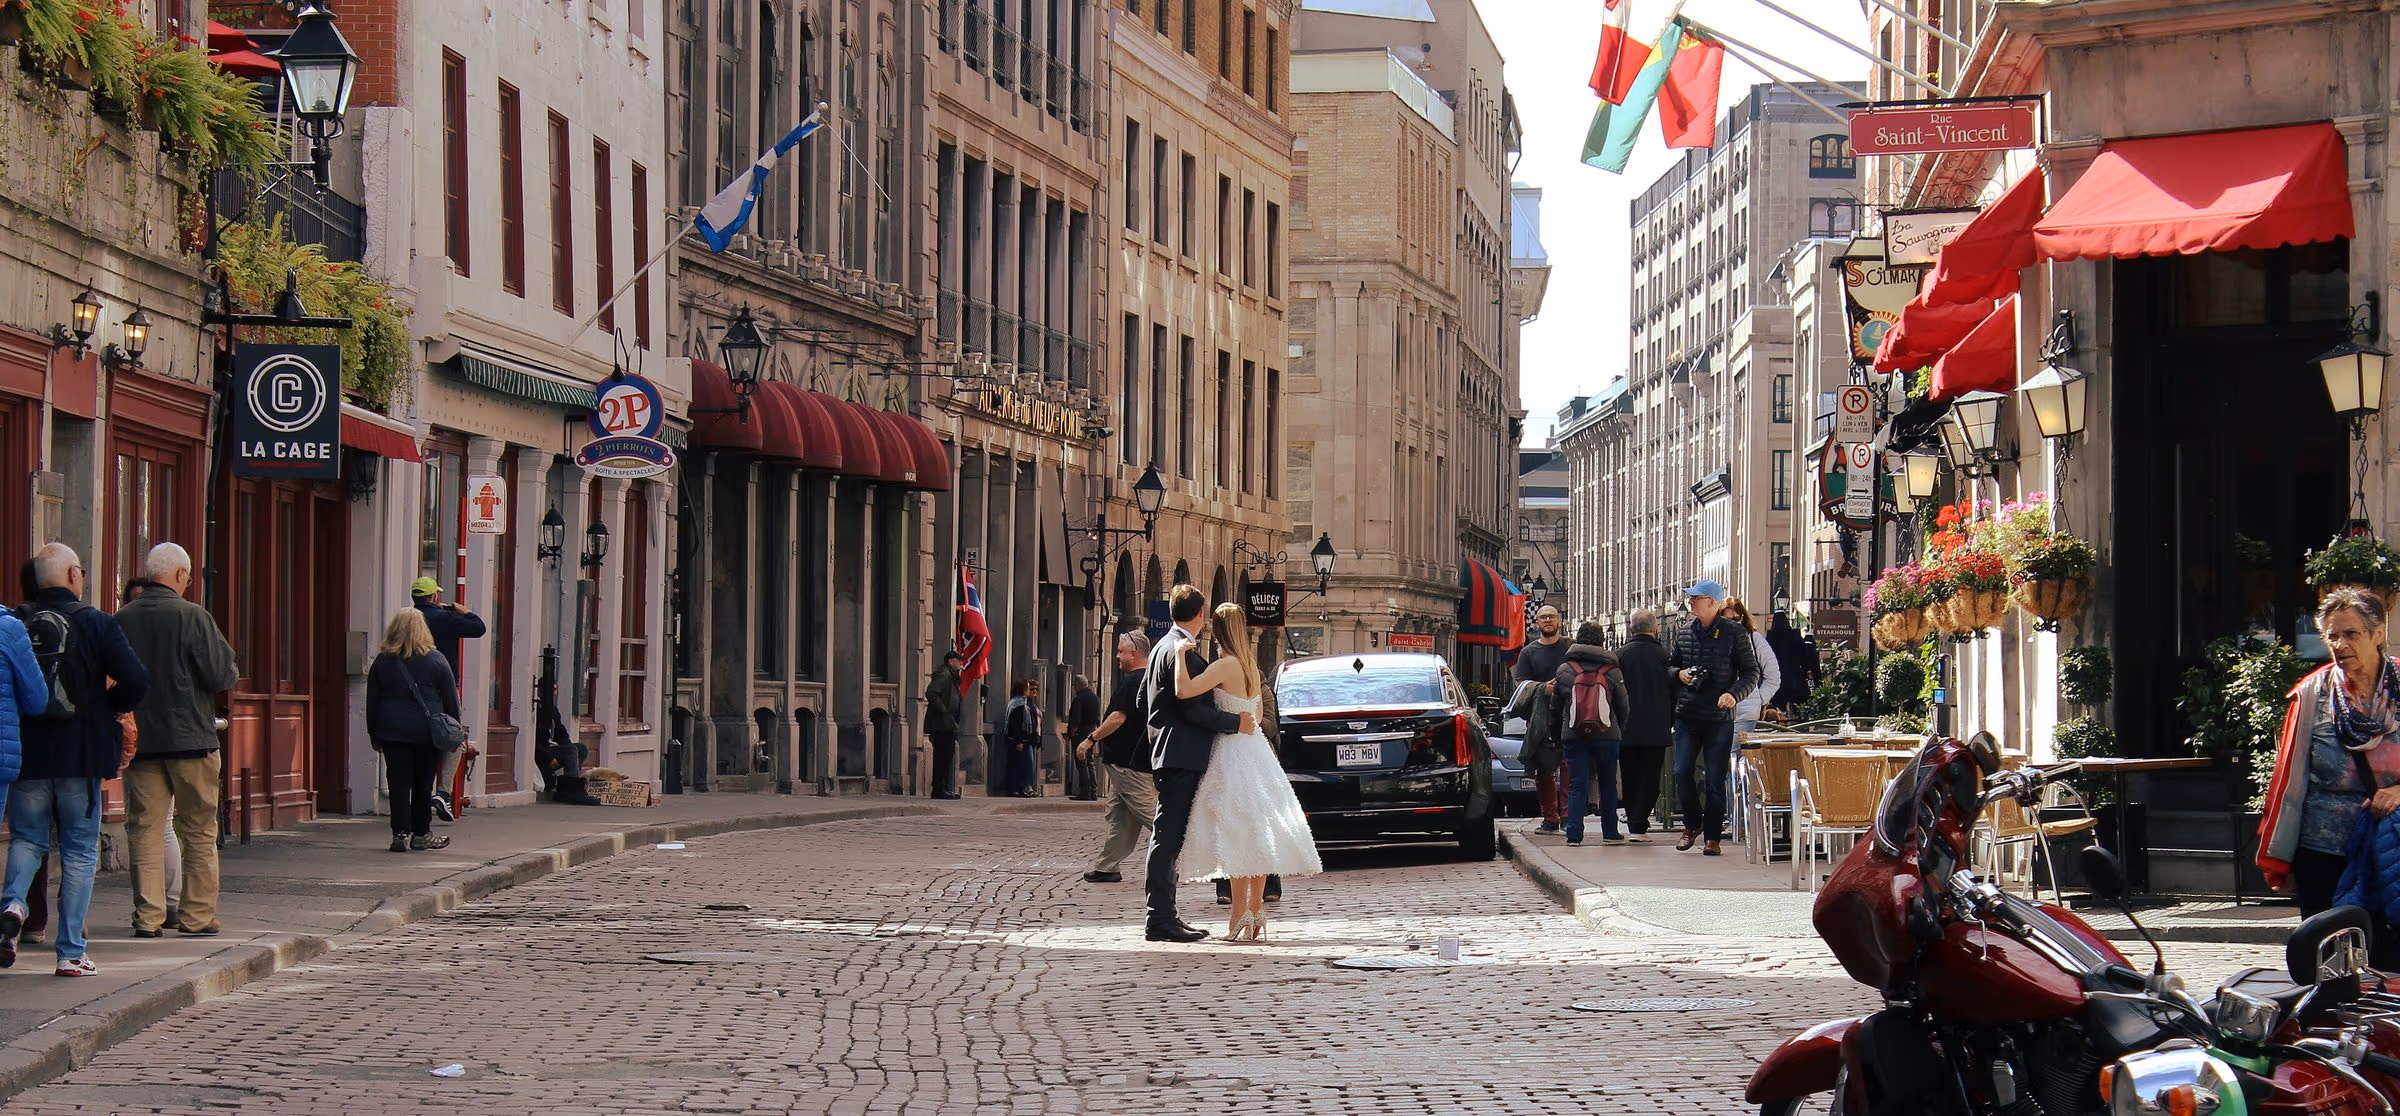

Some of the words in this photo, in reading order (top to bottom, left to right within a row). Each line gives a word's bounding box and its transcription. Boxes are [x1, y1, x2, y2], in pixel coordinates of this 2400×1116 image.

[1930, 113, 1953, 124] Rue
[1874, 123, 2010, 146] Saint-Vincent
[1891, 219, 1914, 236] La
[1891, 225, 1958, 254] Sauvagine
[600, 392, 650, 433] 2P
[241, 440, 266, 458] LA
[274, 441, 331, 459] CAGE
[595, 444, 605, 457] 2
[605, 442, 656, 456] PIERROTS
[619, 466, 656, 476] SPECTACLES
[1250, 592, 1280, 606] DÉLICES
[1150, 619, 1173, 629] l'em
[1393, 638, 1433, 647] Saint-Gabrie
[1338, 749, 1356, 760] W83
[1361, 747, 1379, 760] MBV
[621, 782, 646, 792] THIRSTY
